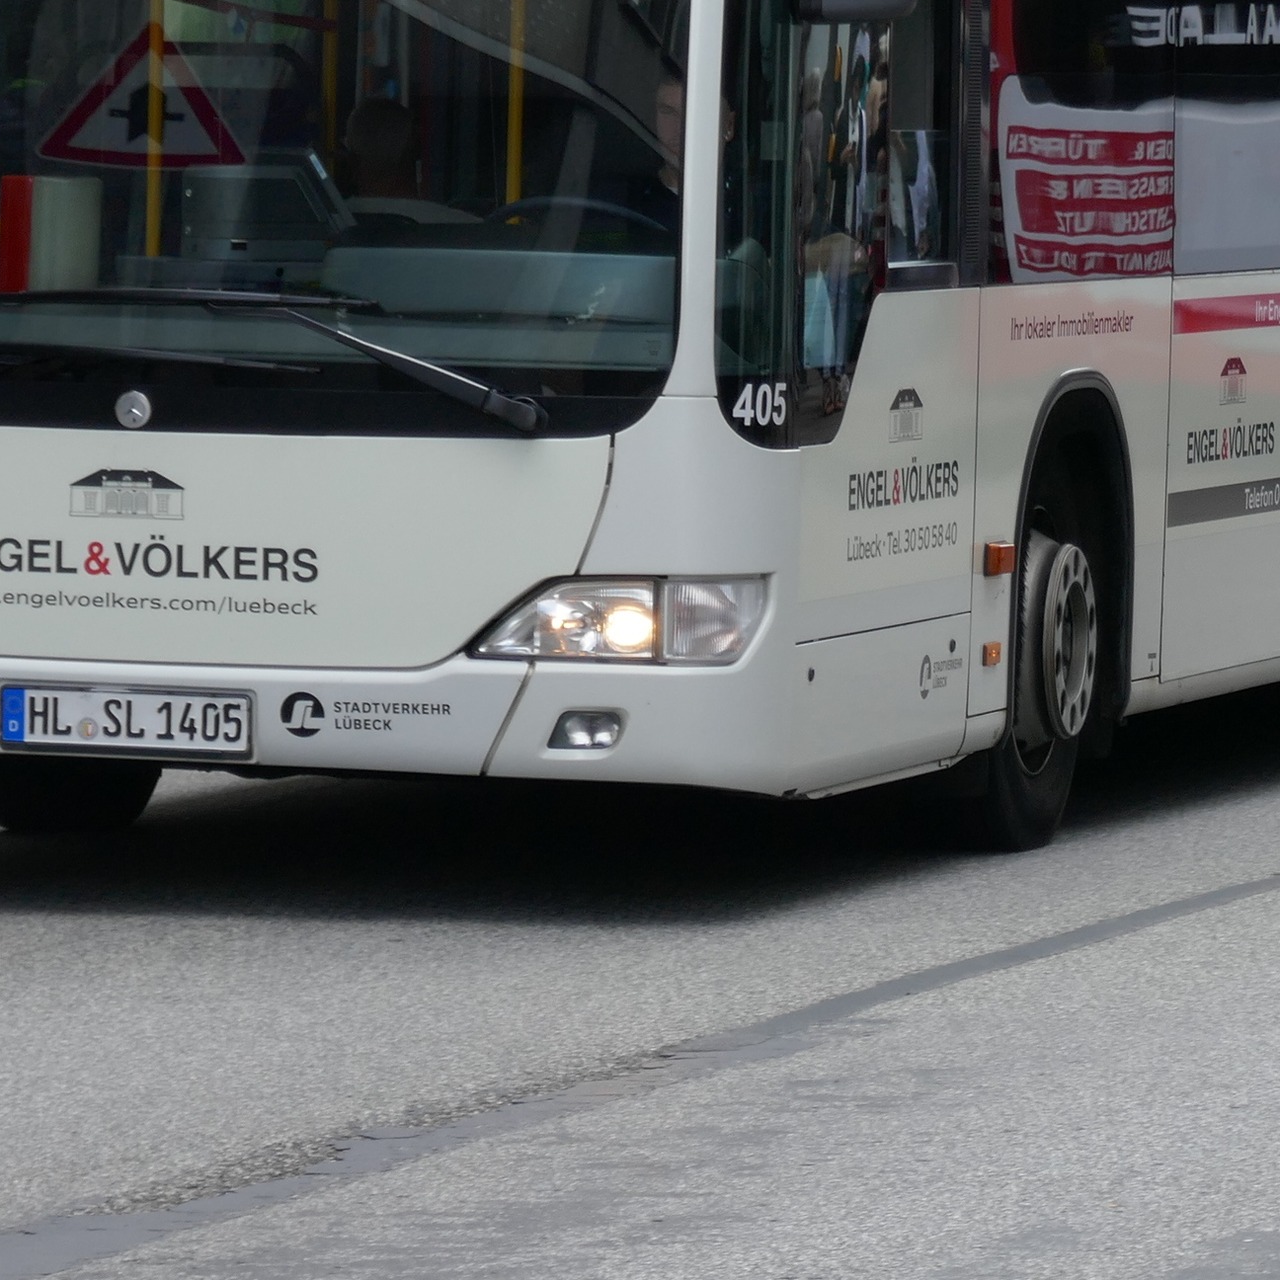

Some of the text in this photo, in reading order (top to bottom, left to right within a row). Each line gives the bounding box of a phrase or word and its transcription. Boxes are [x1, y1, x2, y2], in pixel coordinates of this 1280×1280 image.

[1010, 309, 1134, 341] Ihr lokaler Immobilienmakler
[1255, 300, 1268, 322] Ihr
[732, 382, 787, 426] 405
[1244, 484, 1274, 510] Telefon
[847, 533, 882, 562] Lübeck
[887, 531, 902, 556] Tel.
[29, 696, 72, 736] HL
[102, 699, 145, 739] SL
[156, 702, 243, 744] 1405
[333, 701, 452, 716] STADTVERKEHR
[334, 715, 392, 731] LÜBECK
